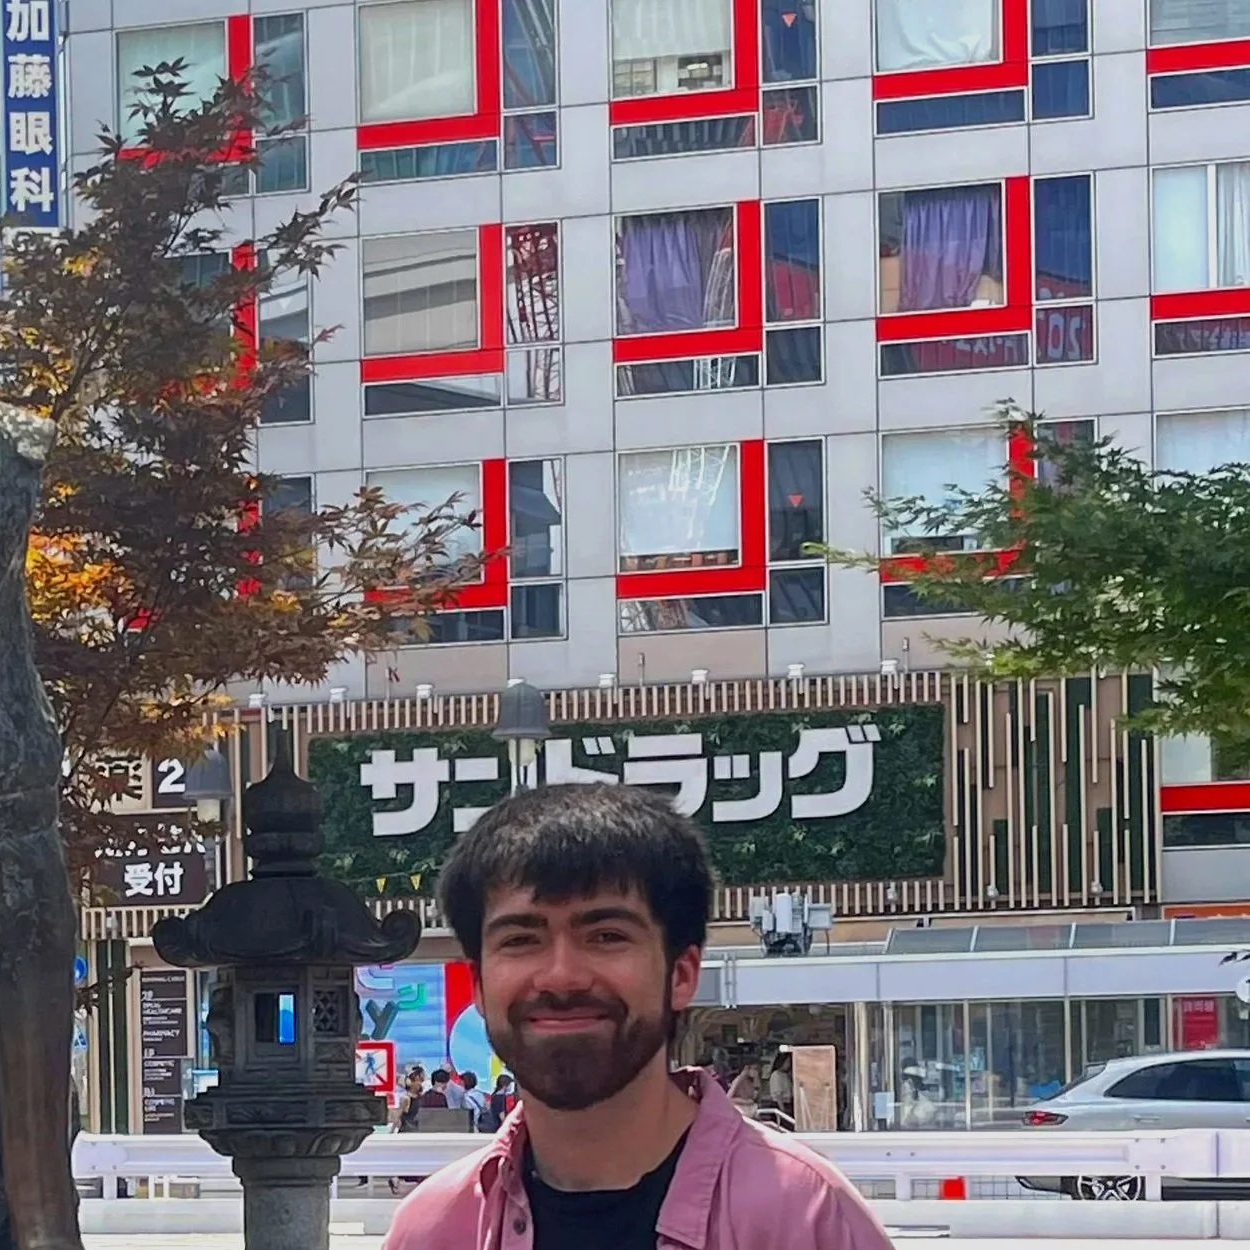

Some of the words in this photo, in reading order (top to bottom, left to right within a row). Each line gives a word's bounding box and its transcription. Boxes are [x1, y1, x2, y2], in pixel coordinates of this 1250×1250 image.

[6, 0, 55, 212] 加藤眼科
[123, 861, 184, 897] 受付
